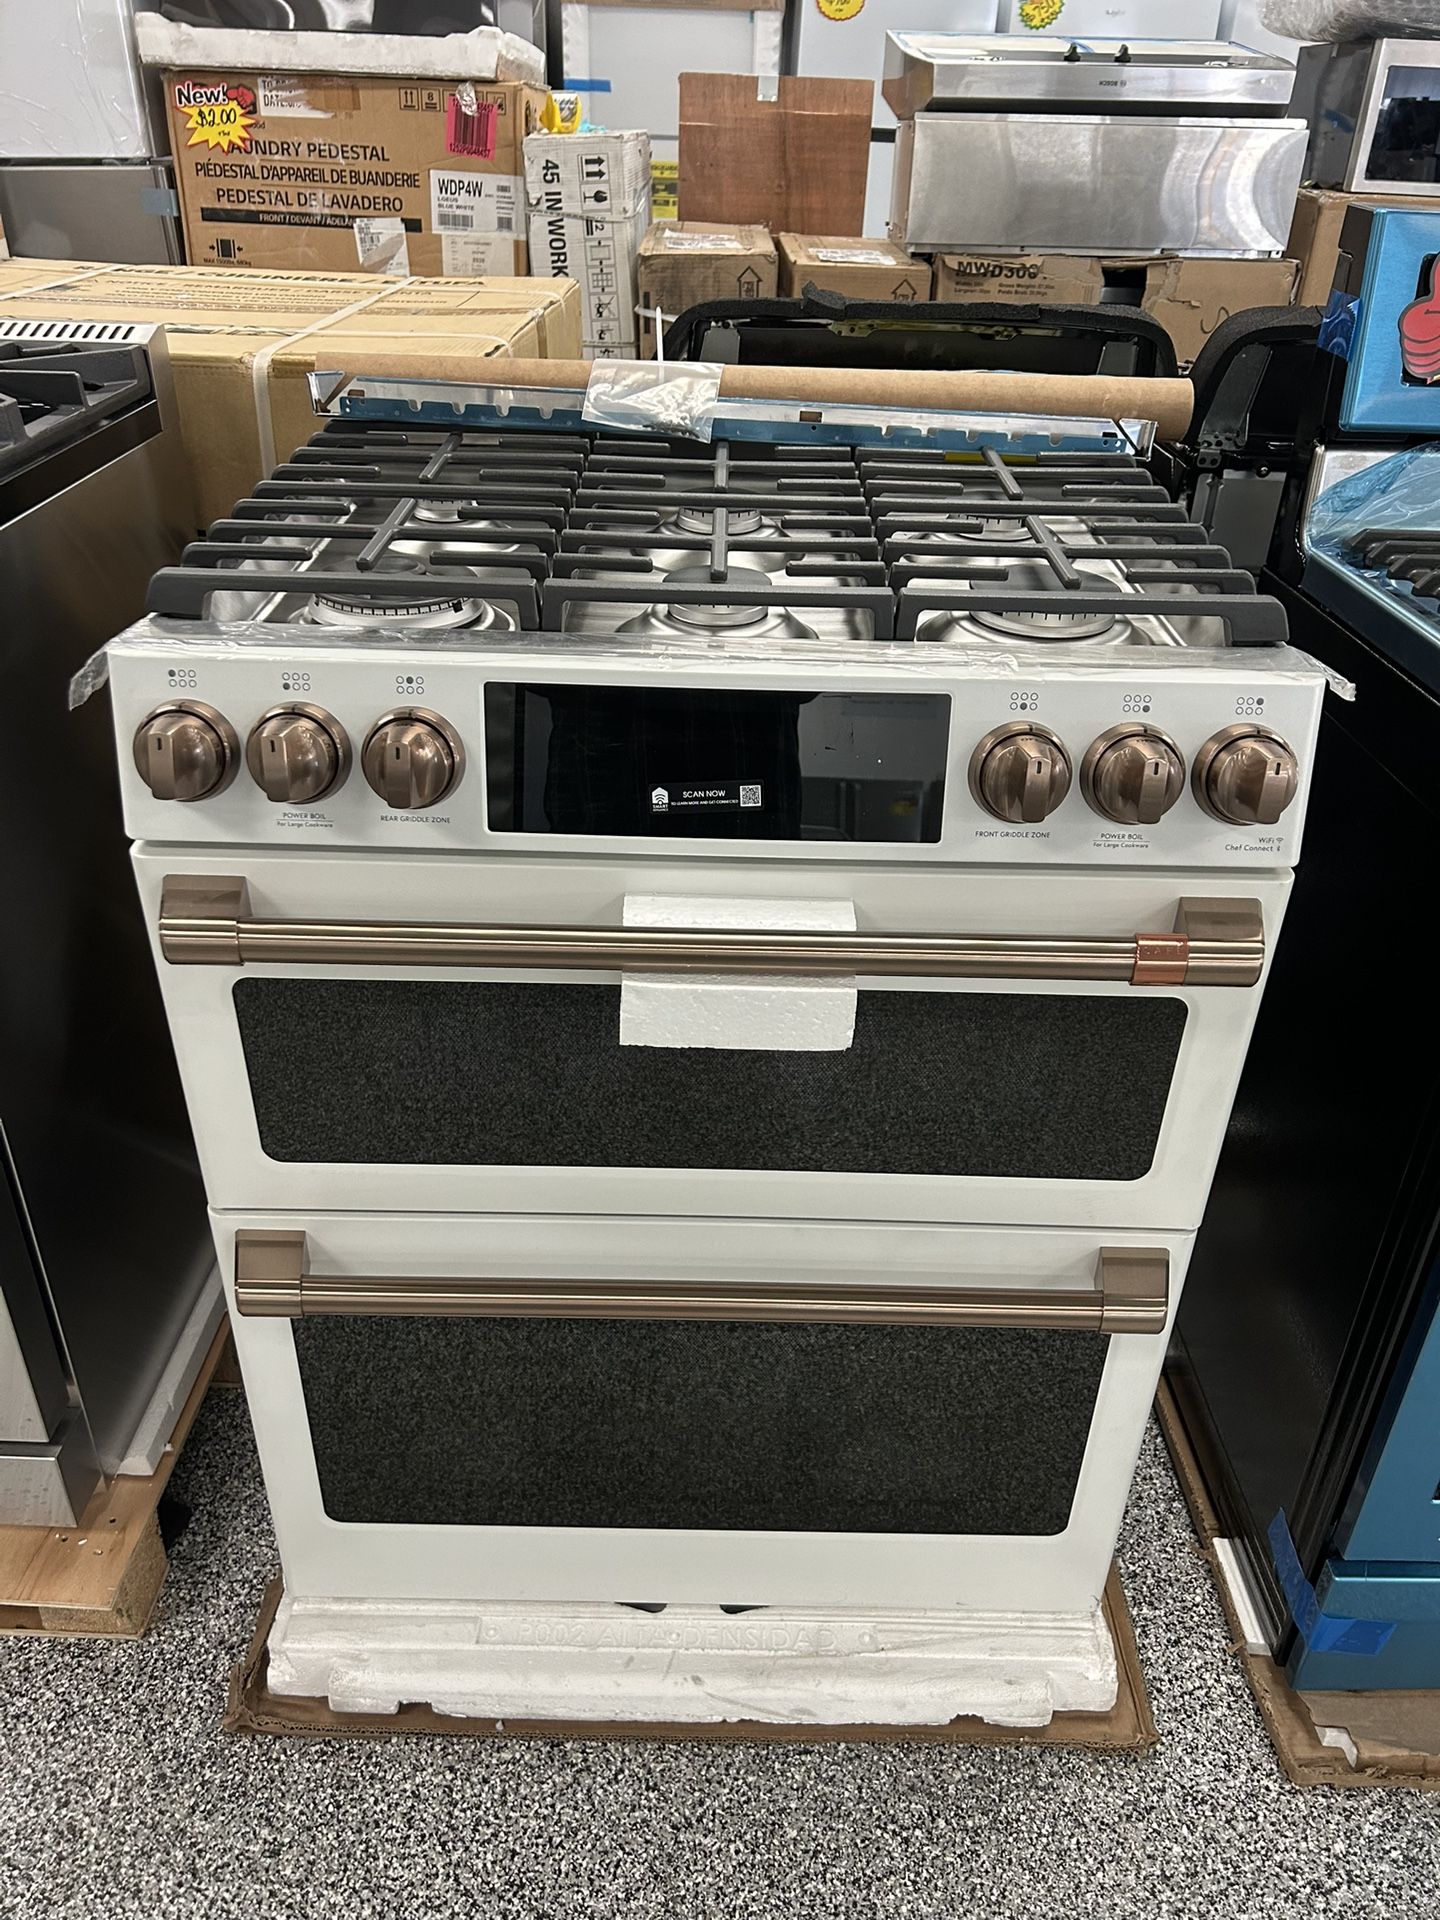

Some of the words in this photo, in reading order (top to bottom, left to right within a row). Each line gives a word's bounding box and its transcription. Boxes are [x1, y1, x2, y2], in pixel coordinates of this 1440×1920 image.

[176, 82, 227, 105] New!
[196, 107, 237, 128] $2.00
[229, 139, 302, 158] AUNDRY
[307, 141, 390, 162] PEDESTAL
[195, 157, 260, 180] PIÉDESTAL
[261, 164, 329, 184] D'APPAREIL
[330, 168, 348, 185] DE
[349, 170, 421, 189] BUANDERIE
[542, 158, 561, 184] 45
[437, 178, 484, 198] WDP4W
[216, 187, 293, 207] PEDESTAL
[297, 192, 317, 208] DE
[321, 193, 404, 213] LAVADERO
[544, 191, 563, 211] IN
[259, 212, 285, 223] FRONT
[290, 214, 321, 225] DEVANT
[547, 217, 569, 278] WORK
[381, 279, 486, 287] ETUFA
[682, 790, 705, 799] SCAN
[706, 789, 726, 798] NOW
[282, 812, 308, 820] POWER
[310, 812, 326, 820] BOIL
[400, 815, 430, 823] GRIDDLE
[431, 816, 450, 824] ZONE
[975, 830, 999, 838] FRONT
[1031, 831, 1051, 839] ZONE
[1100, 832, 1126, 840] POWER
[1243, 844, 1274, 852] Connect
[681, 1626, 839, 1651] DENSIDAD
